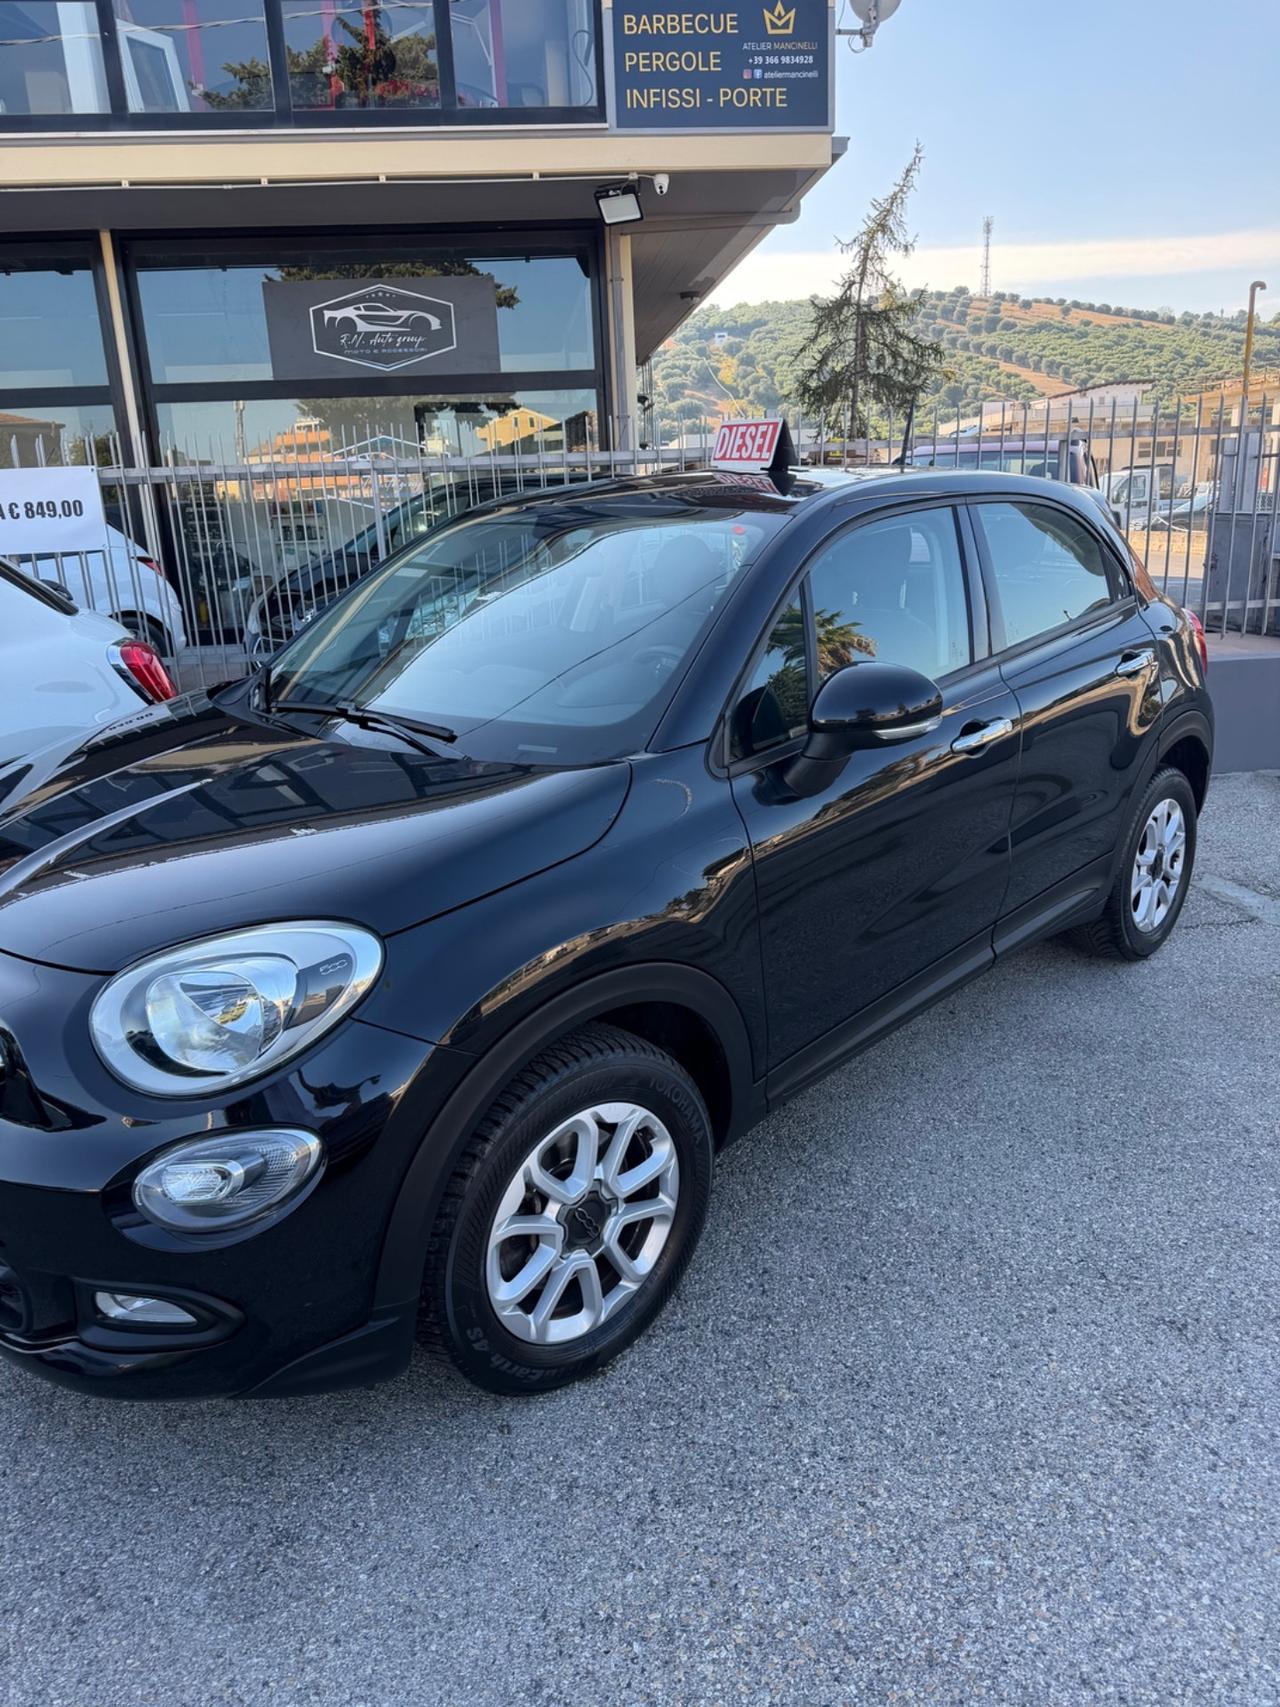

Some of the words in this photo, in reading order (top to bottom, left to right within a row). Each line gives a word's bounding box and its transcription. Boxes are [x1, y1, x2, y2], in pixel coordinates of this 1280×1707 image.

[623, 13, 739, 35] BARBECUE
[742, 41, 772, 50] ATELIER
[773, 41, 818, 50] MANCINELLI
[624, 51, 722, 73] PERGOLE
[748, 55, 763, 65] +39
[764, 55, 779, 65] 366
[780, 55, 814, 65] 9834928
[626, 88, 701, 109] INFISSI
[719, 87, 788, 108] PORTE
[369, 332, 395, 347] Auto
[715, 424, 774, 460] DIESEL
